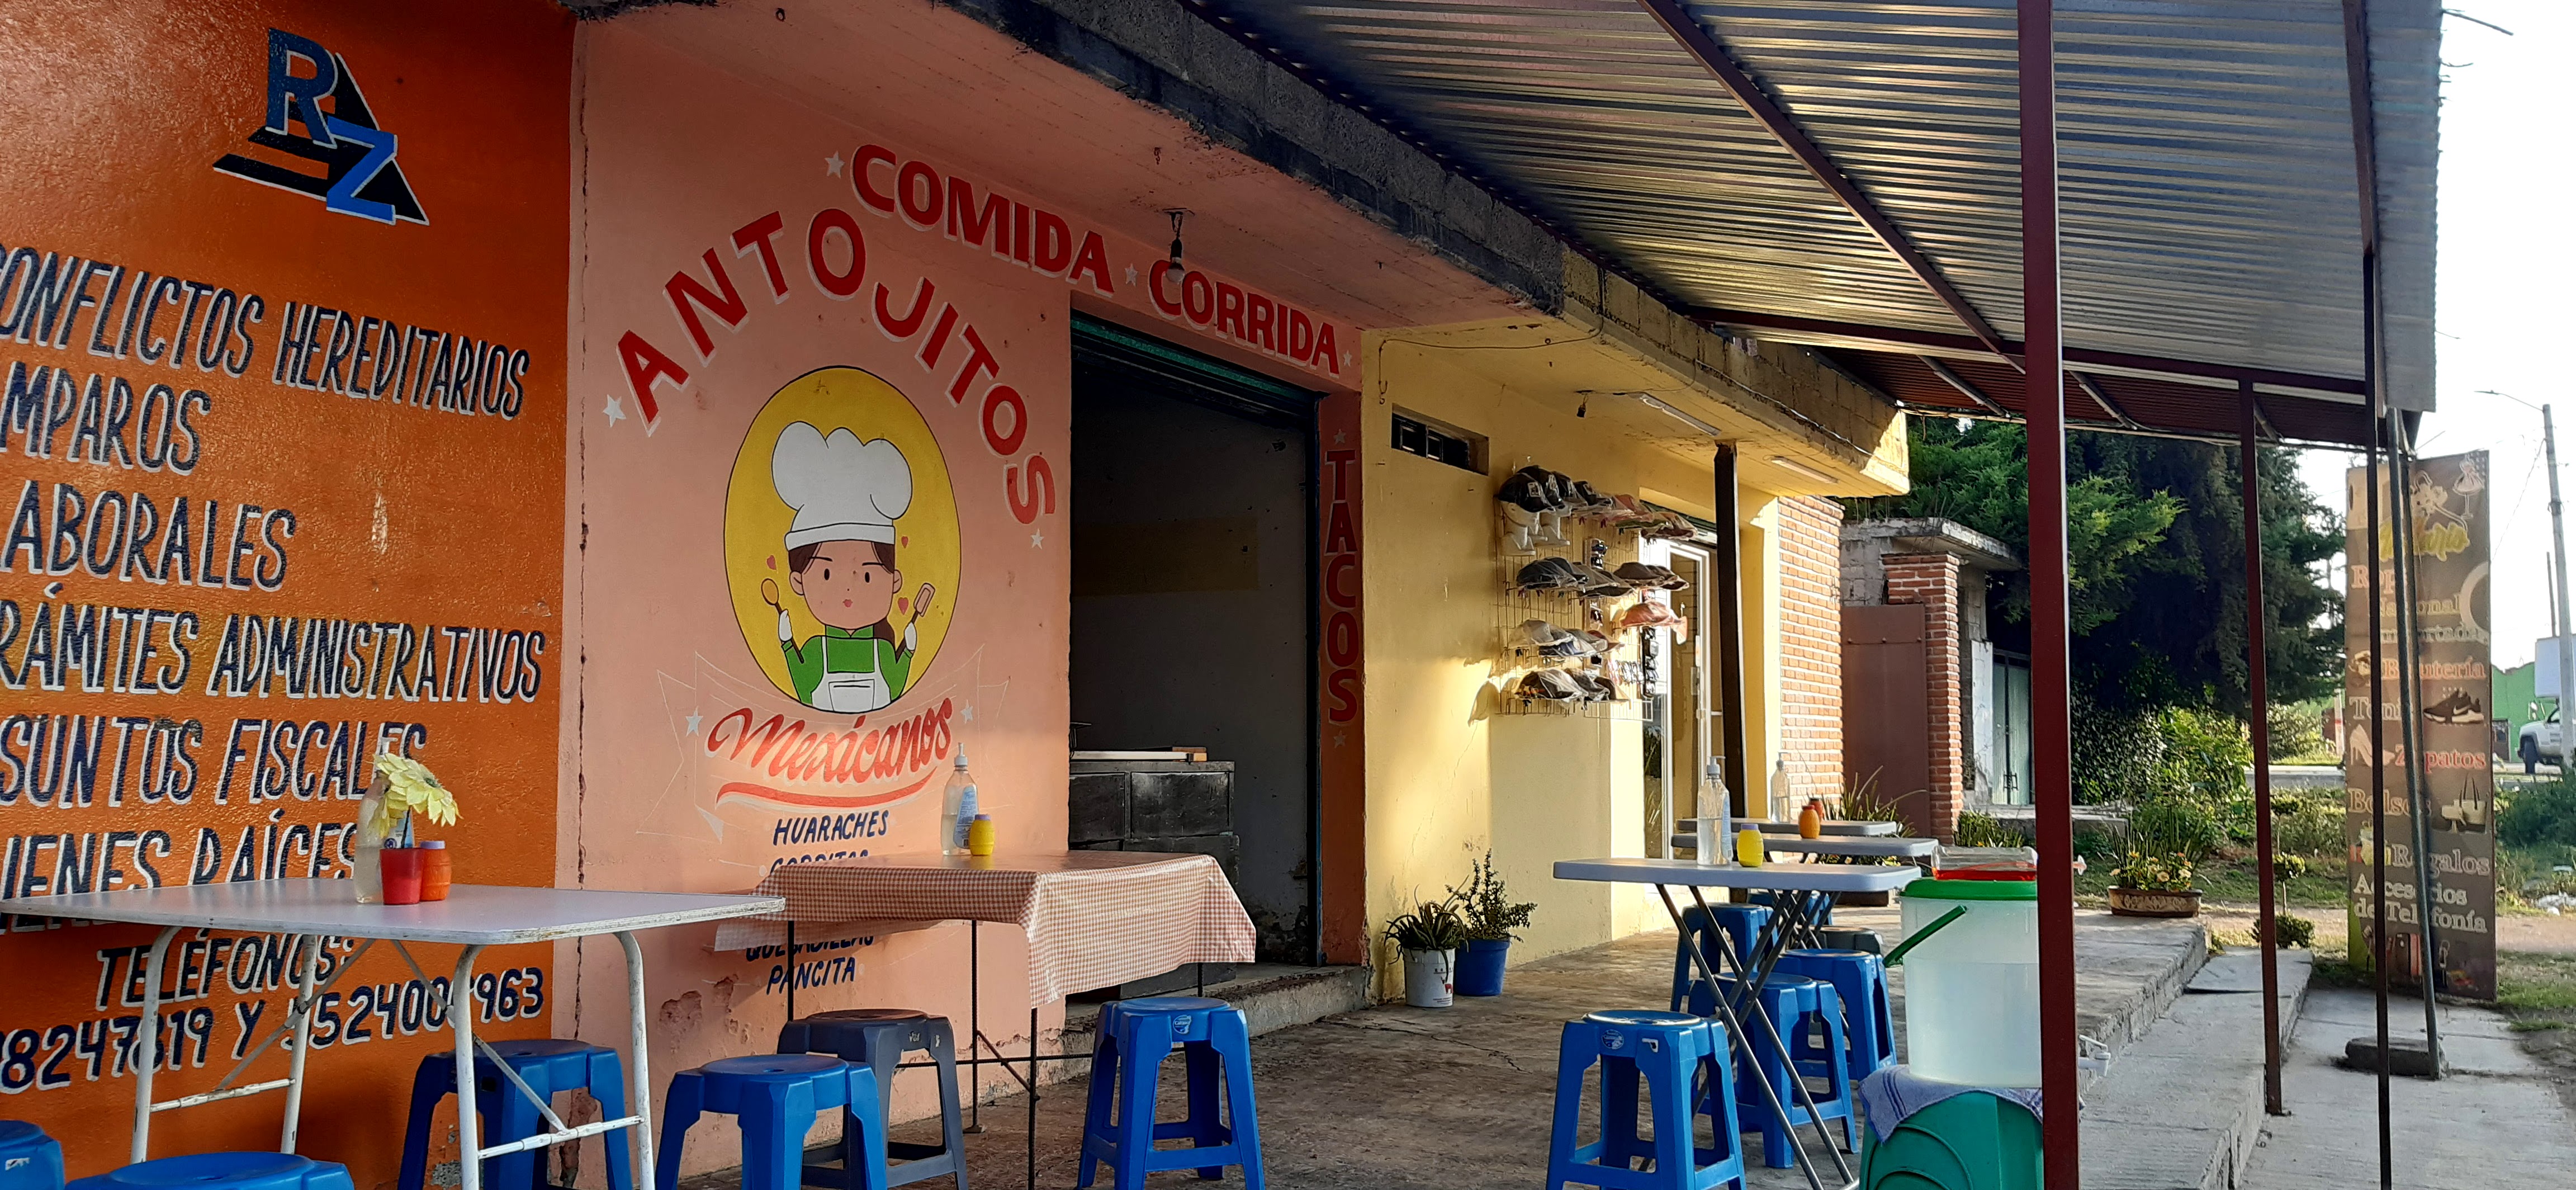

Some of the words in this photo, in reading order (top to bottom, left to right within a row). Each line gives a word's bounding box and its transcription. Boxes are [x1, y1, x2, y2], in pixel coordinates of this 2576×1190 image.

[850, 144, 1115, 298] COMIDA
[1147, 259, 1341, 379] CORRIDA
[0, 243, 265, 379] ONFLICTOS
[272, 300, 530, 420] HEREDITARIOS
[615, 207, 1057, 526] ANTOJITOS
[1324, 449, 1359, 725] TACOS
[205, 613, 545, 703] ADMINISTRATIVOS
[2394, 743, 2487, 774] Zpatos
[773, 809, 890, 846] HUARACHES
[2390, 843, 2490, 879] Rgalos
[2385, 900, 2488, 934] Telfonía
[0, 1007, 214, 1094] 8247819
[231, 999, 266, 1060] Y
